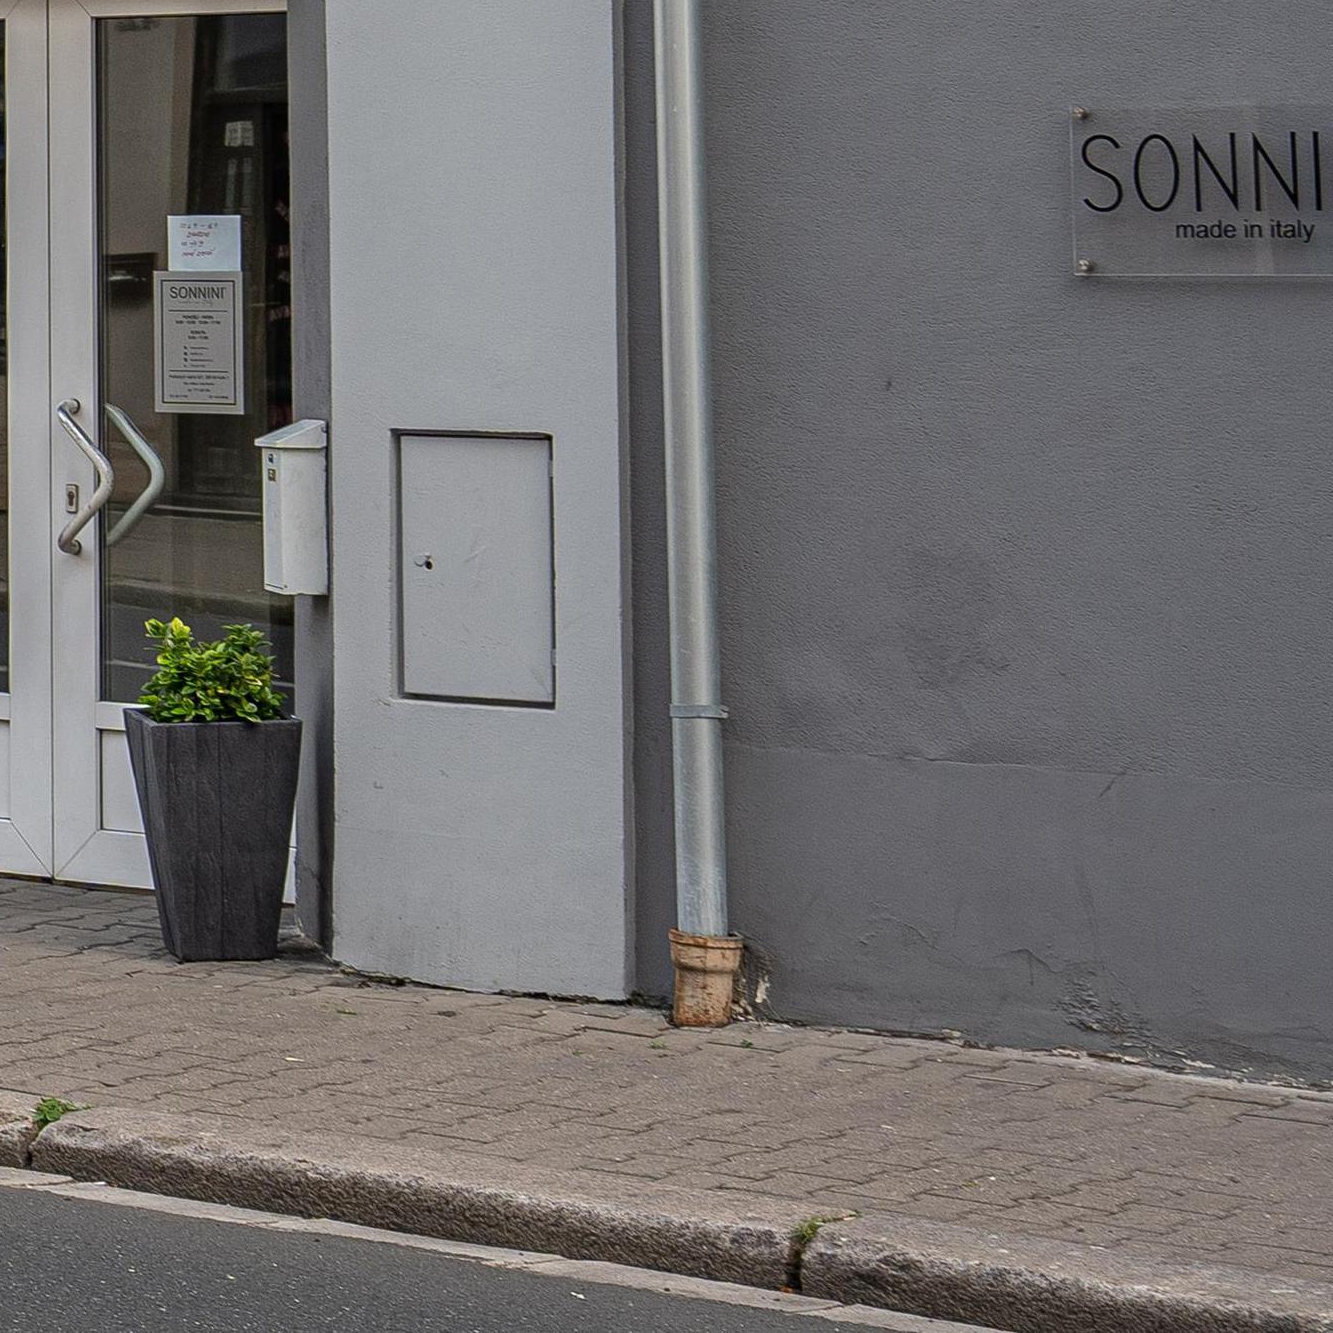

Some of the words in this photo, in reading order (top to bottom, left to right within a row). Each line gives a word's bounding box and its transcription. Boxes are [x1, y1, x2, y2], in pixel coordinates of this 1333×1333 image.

[1176, 219, 1237, 238] made
[1244, 219, 1262, 238] in
[1271, 219, 1315, 243] italy
